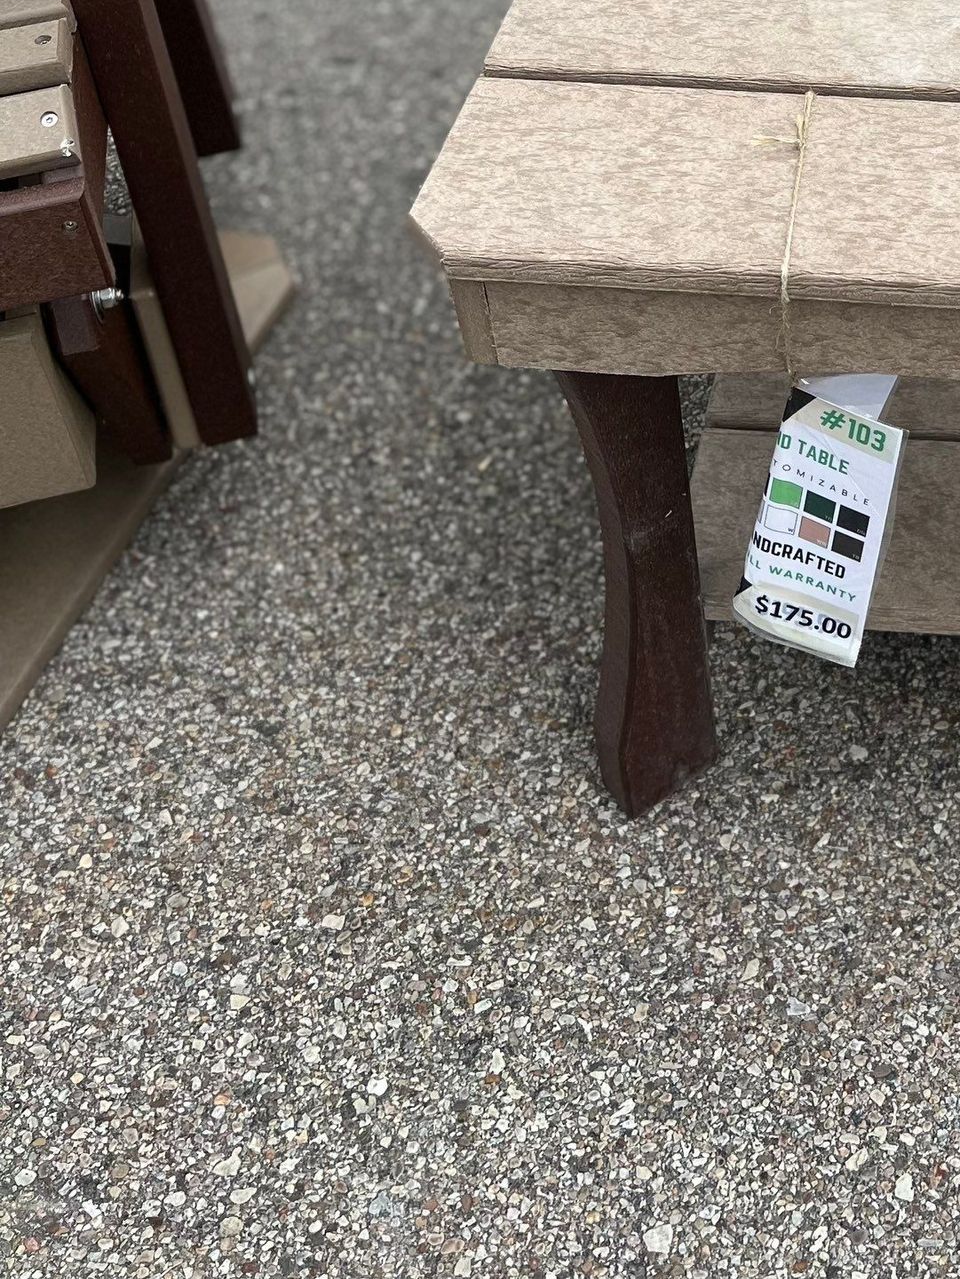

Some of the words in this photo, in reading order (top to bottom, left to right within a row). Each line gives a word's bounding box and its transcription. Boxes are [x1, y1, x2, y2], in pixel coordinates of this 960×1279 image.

[819, 409, 887, 453] #103
[798, 439, 850, 475] TABLE
[768, 565, 857, 602] WARRANTY
[754, 594, 852, 639] $175.00
